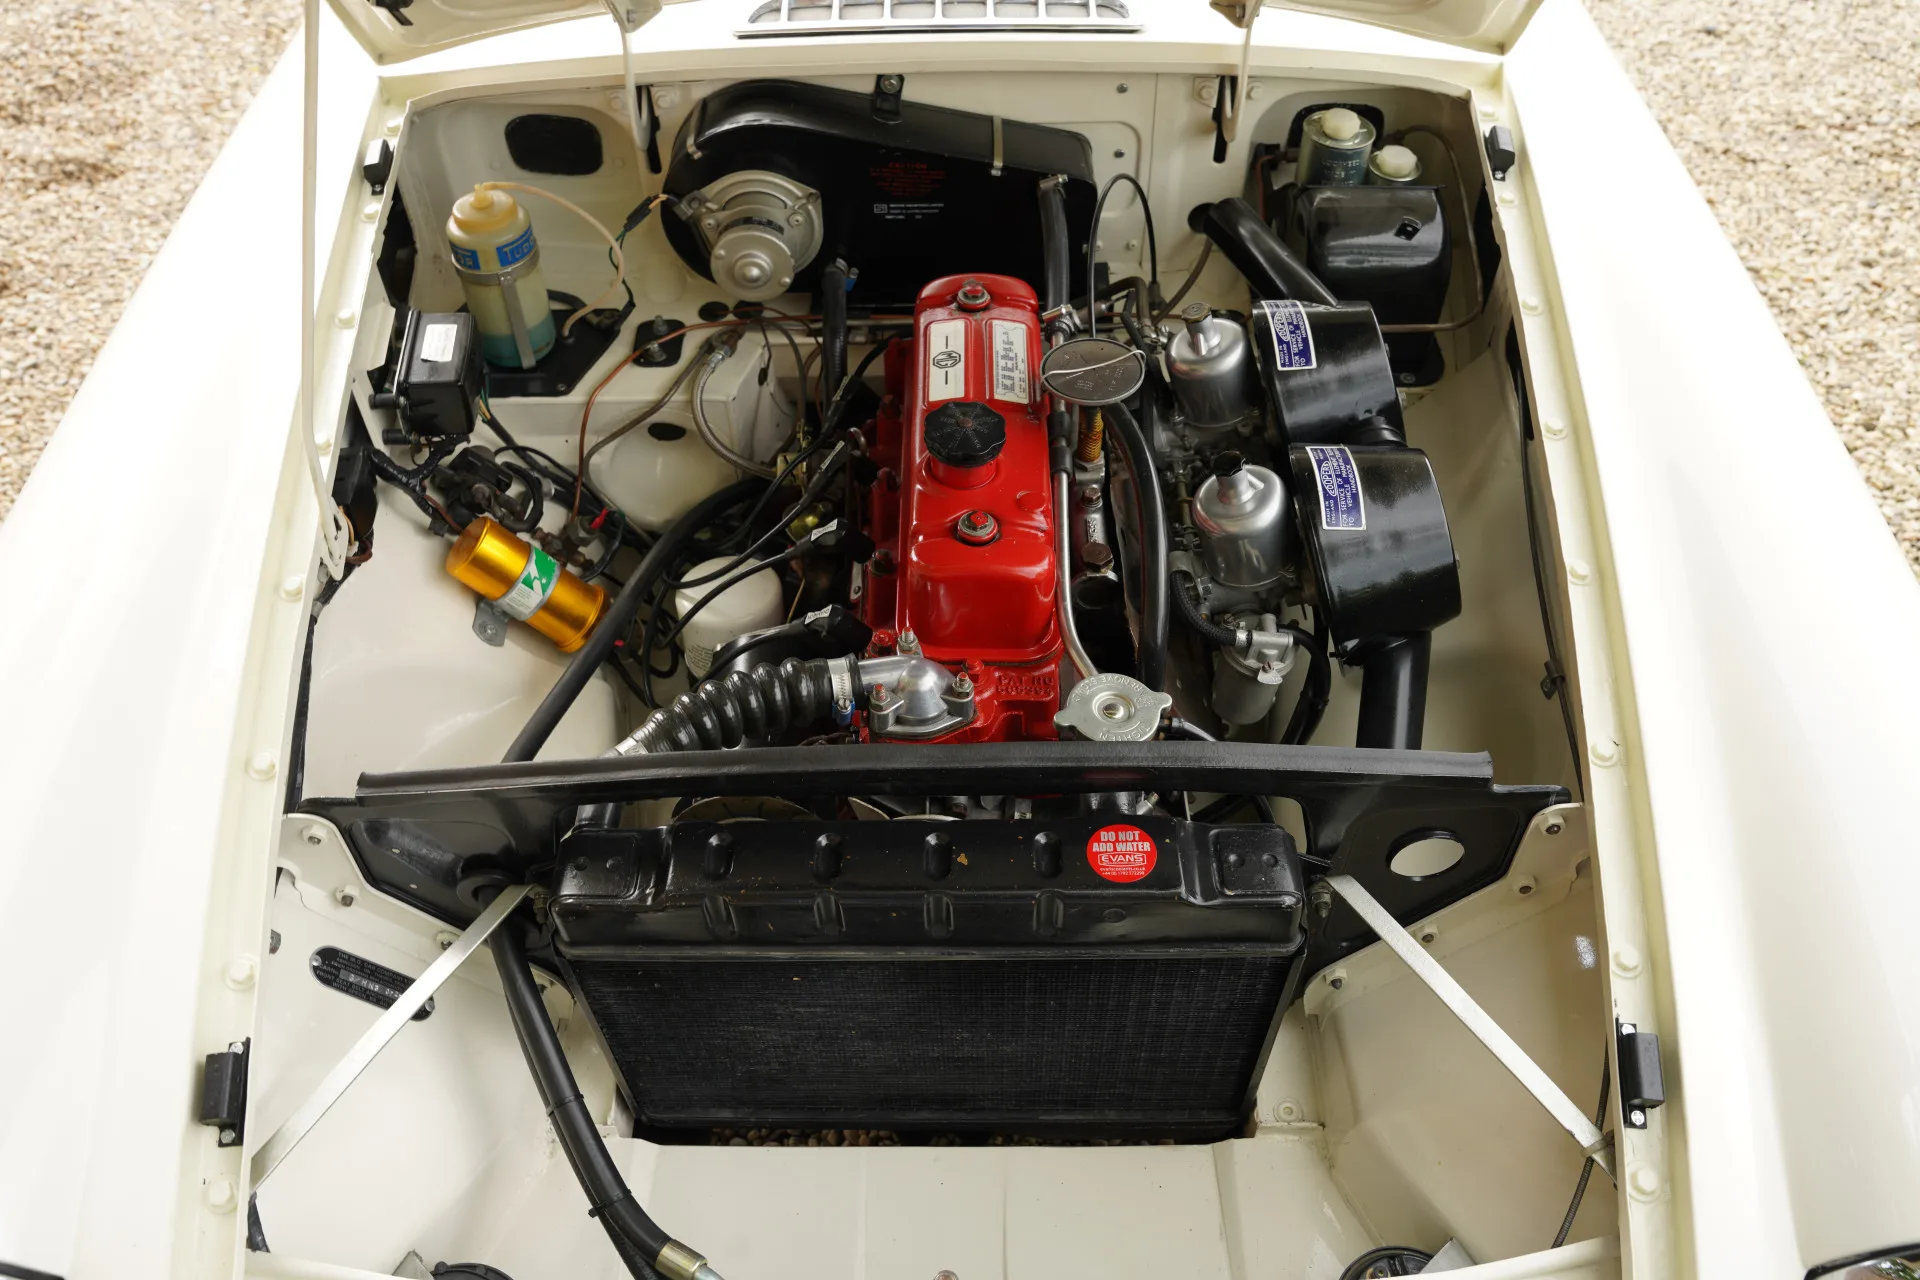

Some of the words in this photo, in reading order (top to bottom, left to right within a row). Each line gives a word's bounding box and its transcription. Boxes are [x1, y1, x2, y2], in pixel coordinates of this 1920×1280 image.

[1291, 333, 1299, 353] SERVICE
[1300, 358, 1306, 366] TO
[1331, 457, 1341, 474] ELEMENT
[1346, 464, 1357, 493] HANDBOOK
[1339, 488, 1347, 510] SERVICE
[1344, 484, 1353, 507] VEHICLE
[1349, 517, 1355, 526] TO
[998, 675, 1030, 687] PAT
[1101, 675, 1143, 692] REMOVE
[1100, 831, 1116, 841] DO
[1118, 831, 1140, 841] NOT
[1092, 842, 1114, 852] ADD
[1116, 841, 1151, 852] WATER
[1102, 854, 1143, 862] EVANS
[364, 962, 376, 970] CAR
